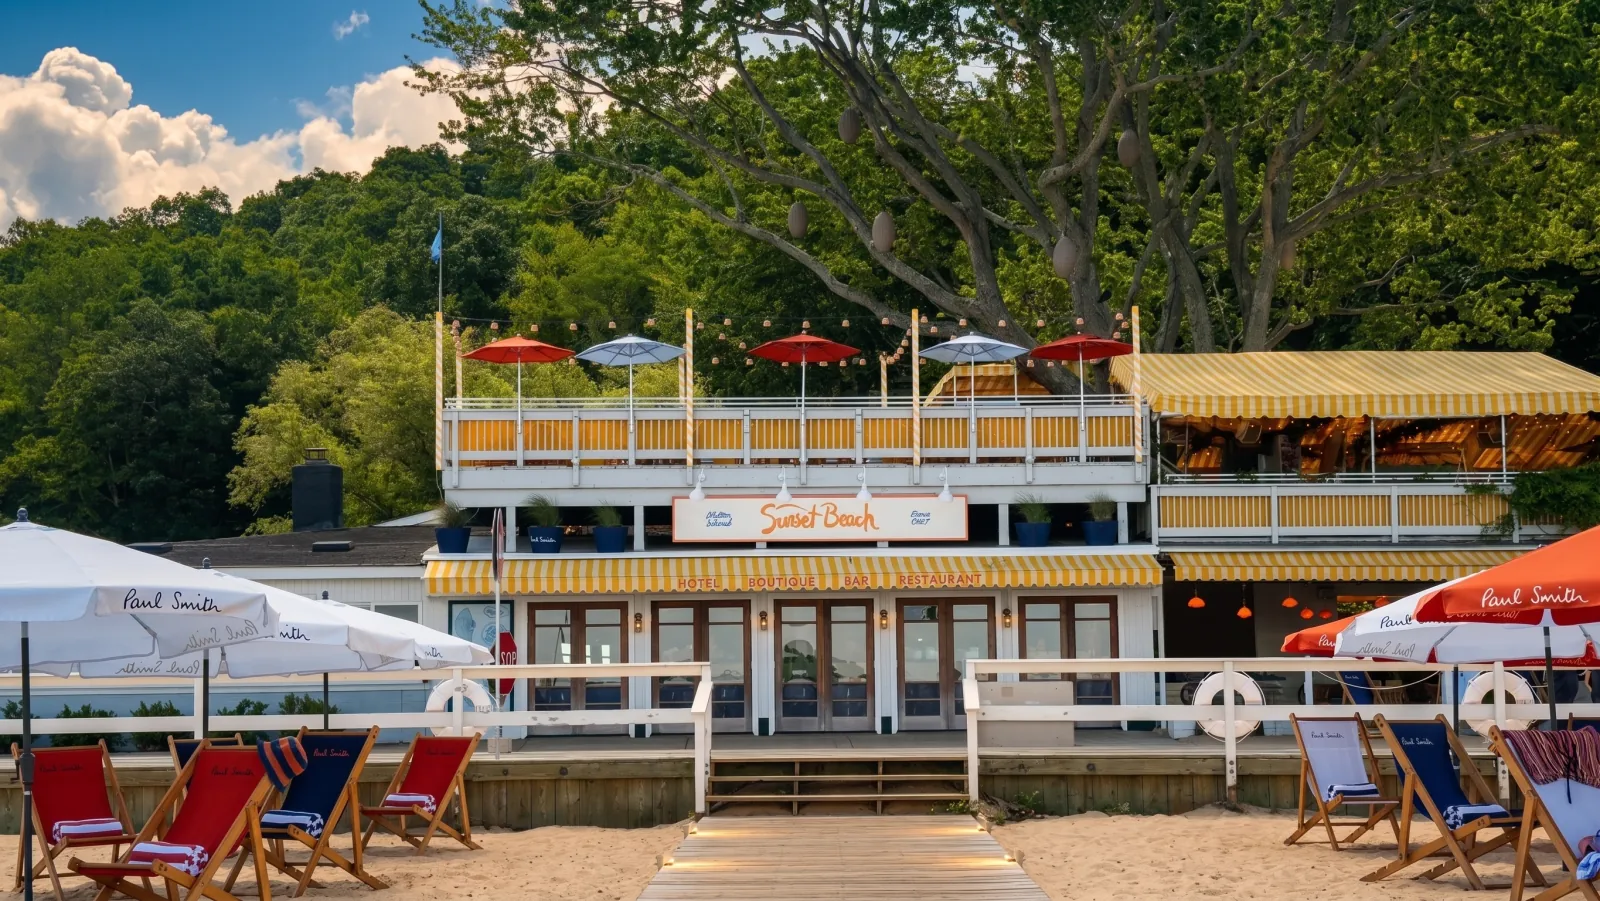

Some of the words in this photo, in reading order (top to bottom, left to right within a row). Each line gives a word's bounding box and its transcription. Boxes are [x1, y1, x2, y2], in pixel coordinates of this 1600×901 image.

[760, 503, 823, 535] Sunset
[820, 502, 880, 532] Beach
[678, 578, 720, 588] HOTEL
[748, 576, 815, 588] BOUTIQUE
[844, 575, 869, 586] BAR
[899, 573, 982, 585] RESTAURANT
[123, 588, 163, 610] Paul
[172, 591, 222, 612] Smith
[1481, 587, 1523, 608] Paul
[1531, 585, 1589, 604] Smith
[1380, 614, 1412, 629] Paul
[280, 624, 311, 641] ith
[1318, 633, 1336, 647] Pau
